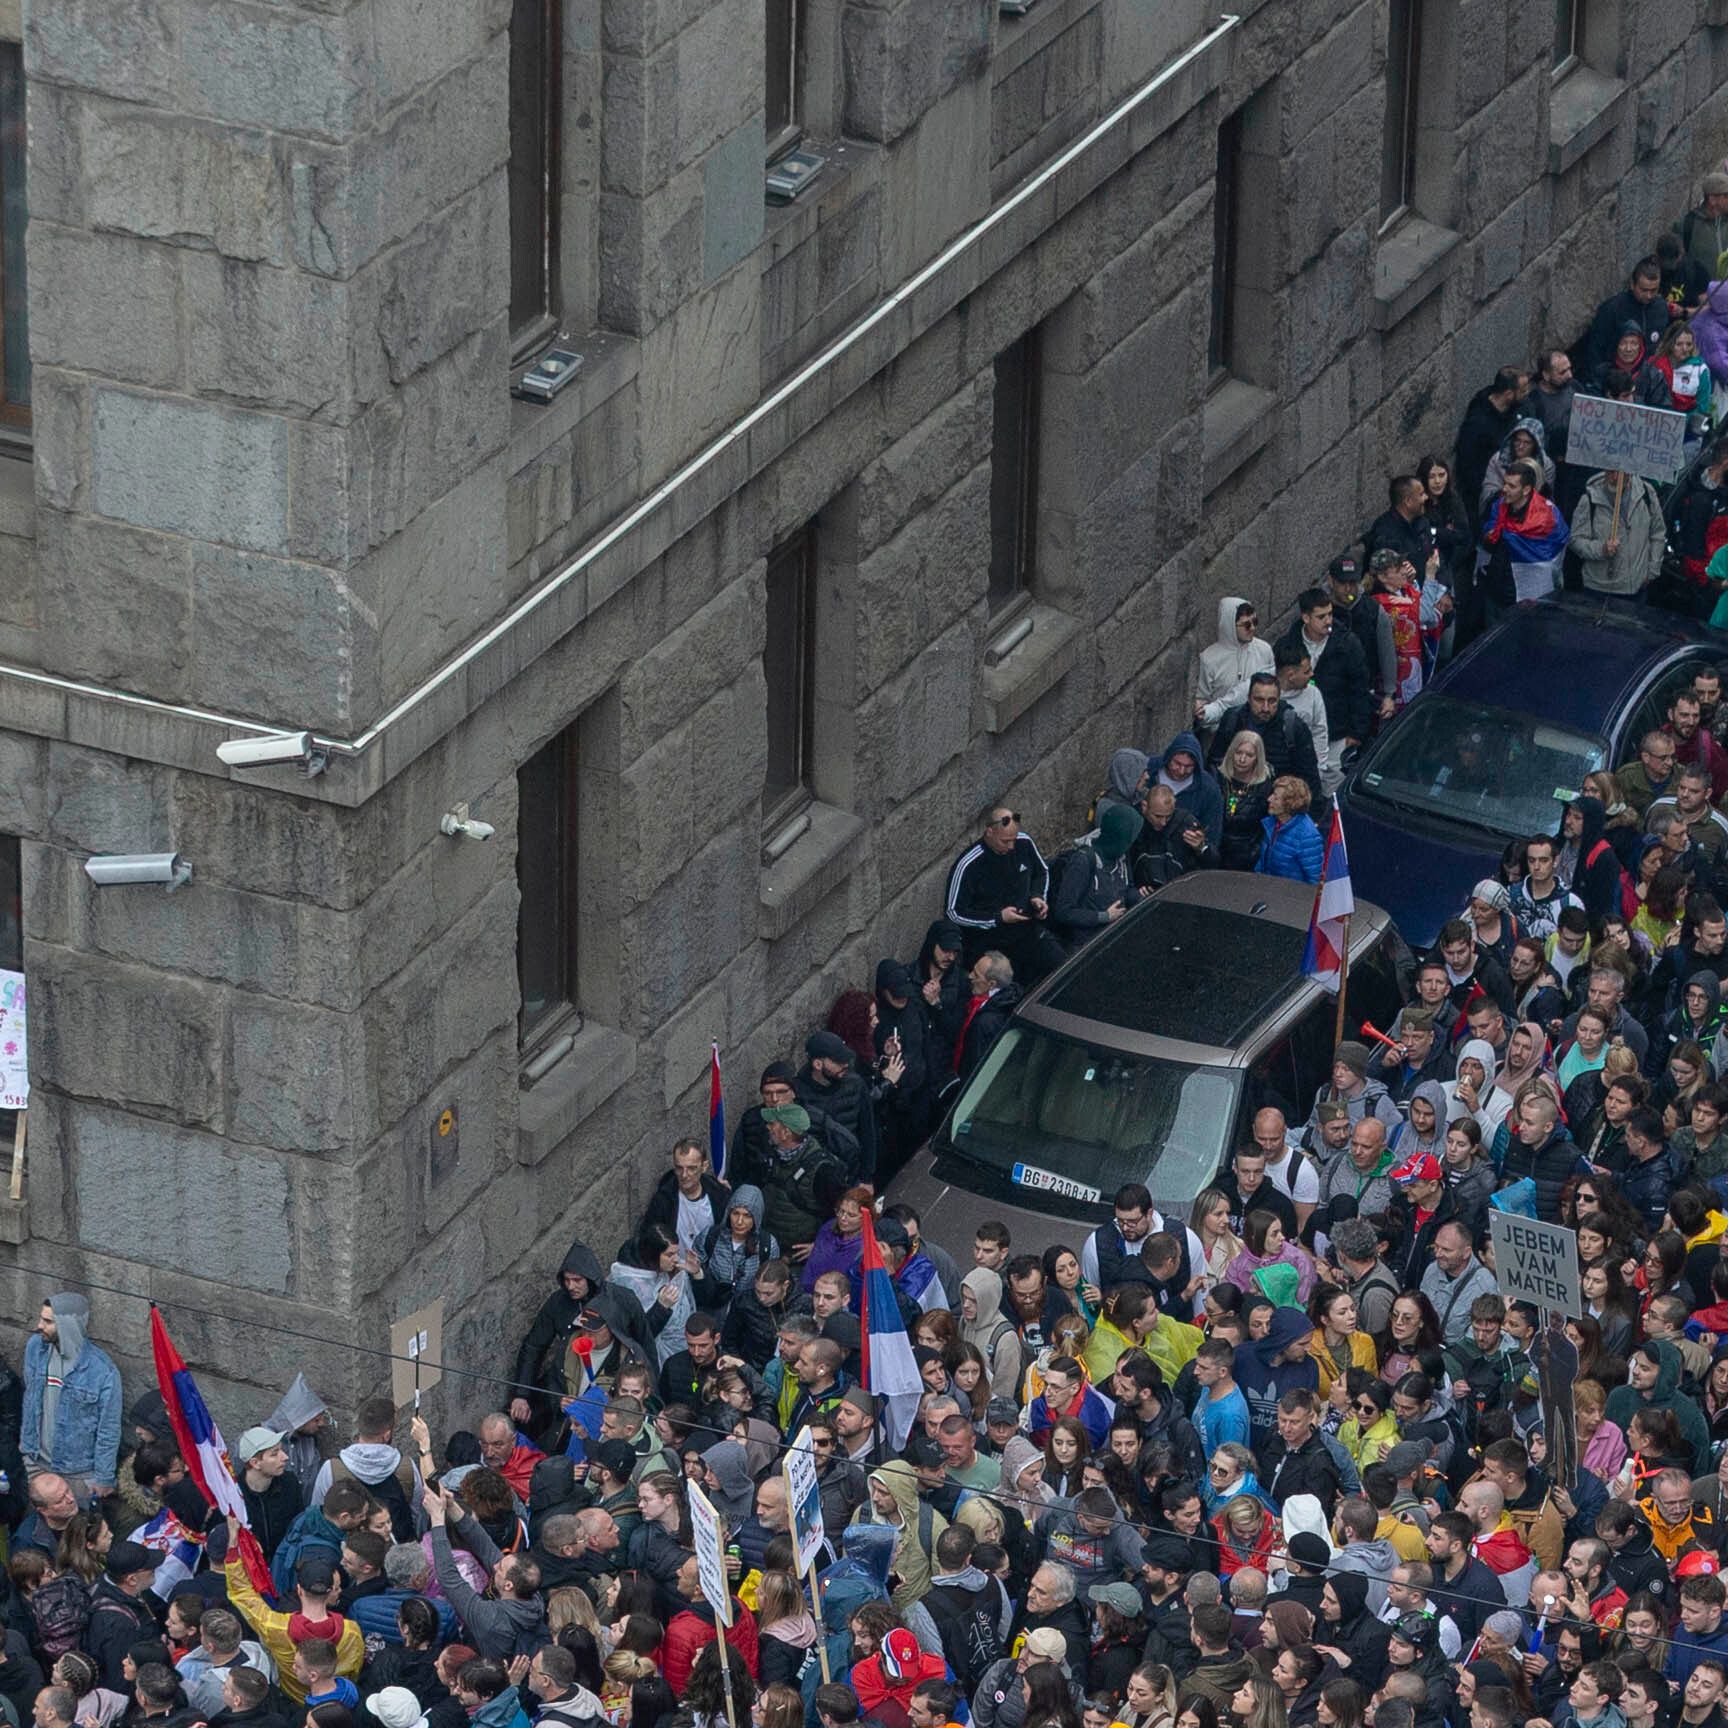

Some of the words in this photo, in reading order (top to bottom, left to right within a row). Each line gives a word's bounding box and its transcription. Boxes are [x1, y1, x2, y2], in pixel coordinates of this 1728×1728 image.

[1024, 1168, 1040, 1186] BG
[1502, 1224, 1565, 1258] JEBEM
[1513, 1248, 1557, 1279] VAM
[1507, 1268, 1568, 1304] MATER
